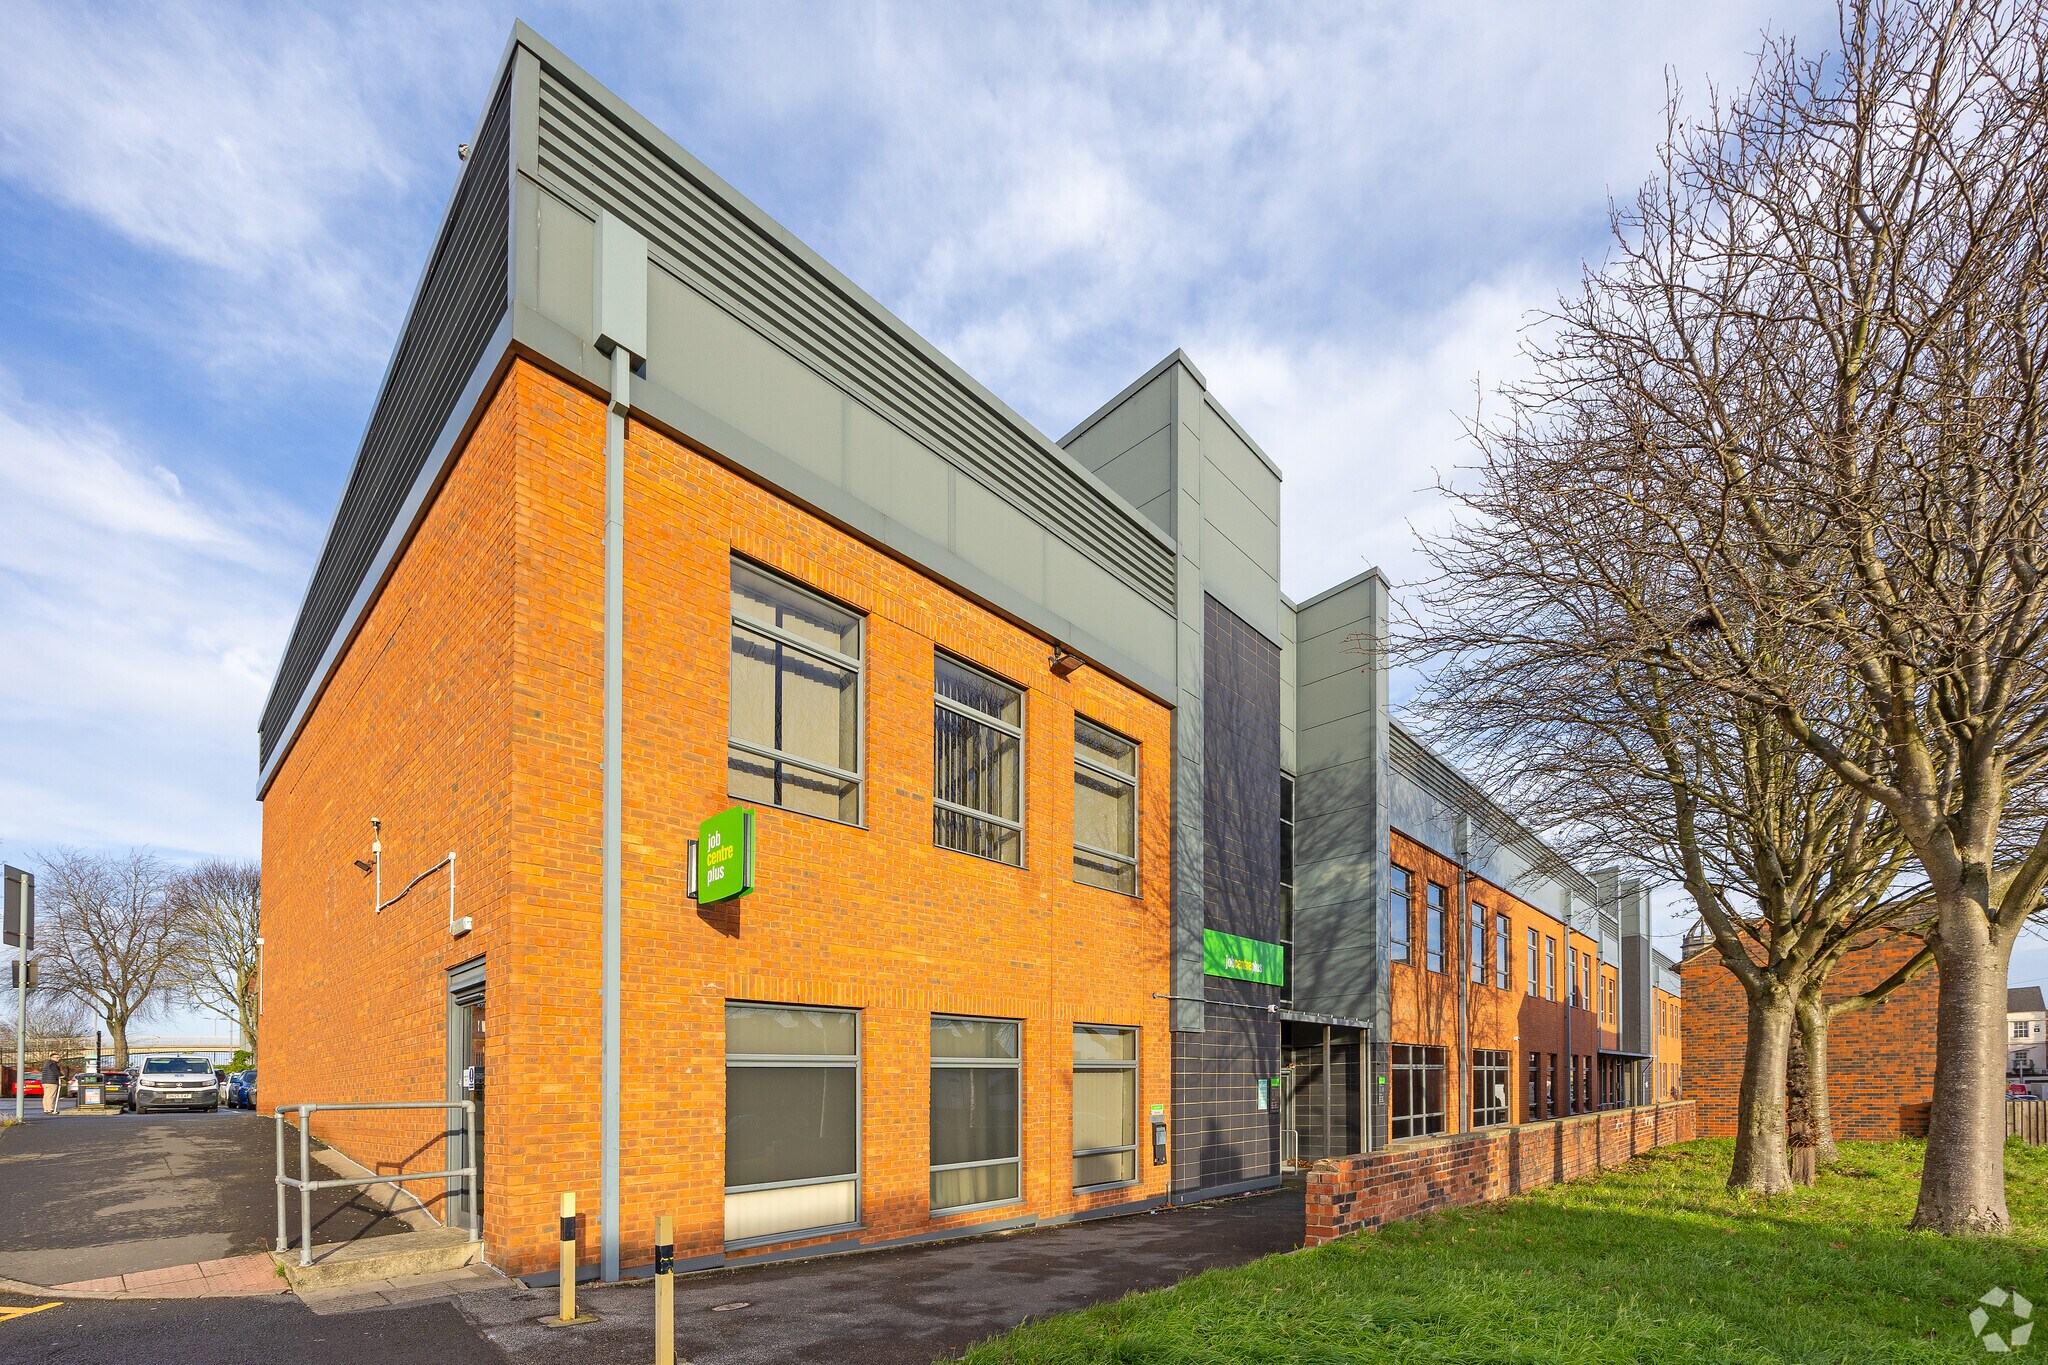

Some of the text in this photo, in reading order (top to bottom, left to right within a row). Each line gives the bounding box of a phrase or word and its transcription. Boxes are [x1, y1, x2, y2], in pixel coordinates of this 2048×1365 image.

[707, 830, 721, 853] job
[707, 844, 734, 866] centre
[707, 865, 725, 887] plus
